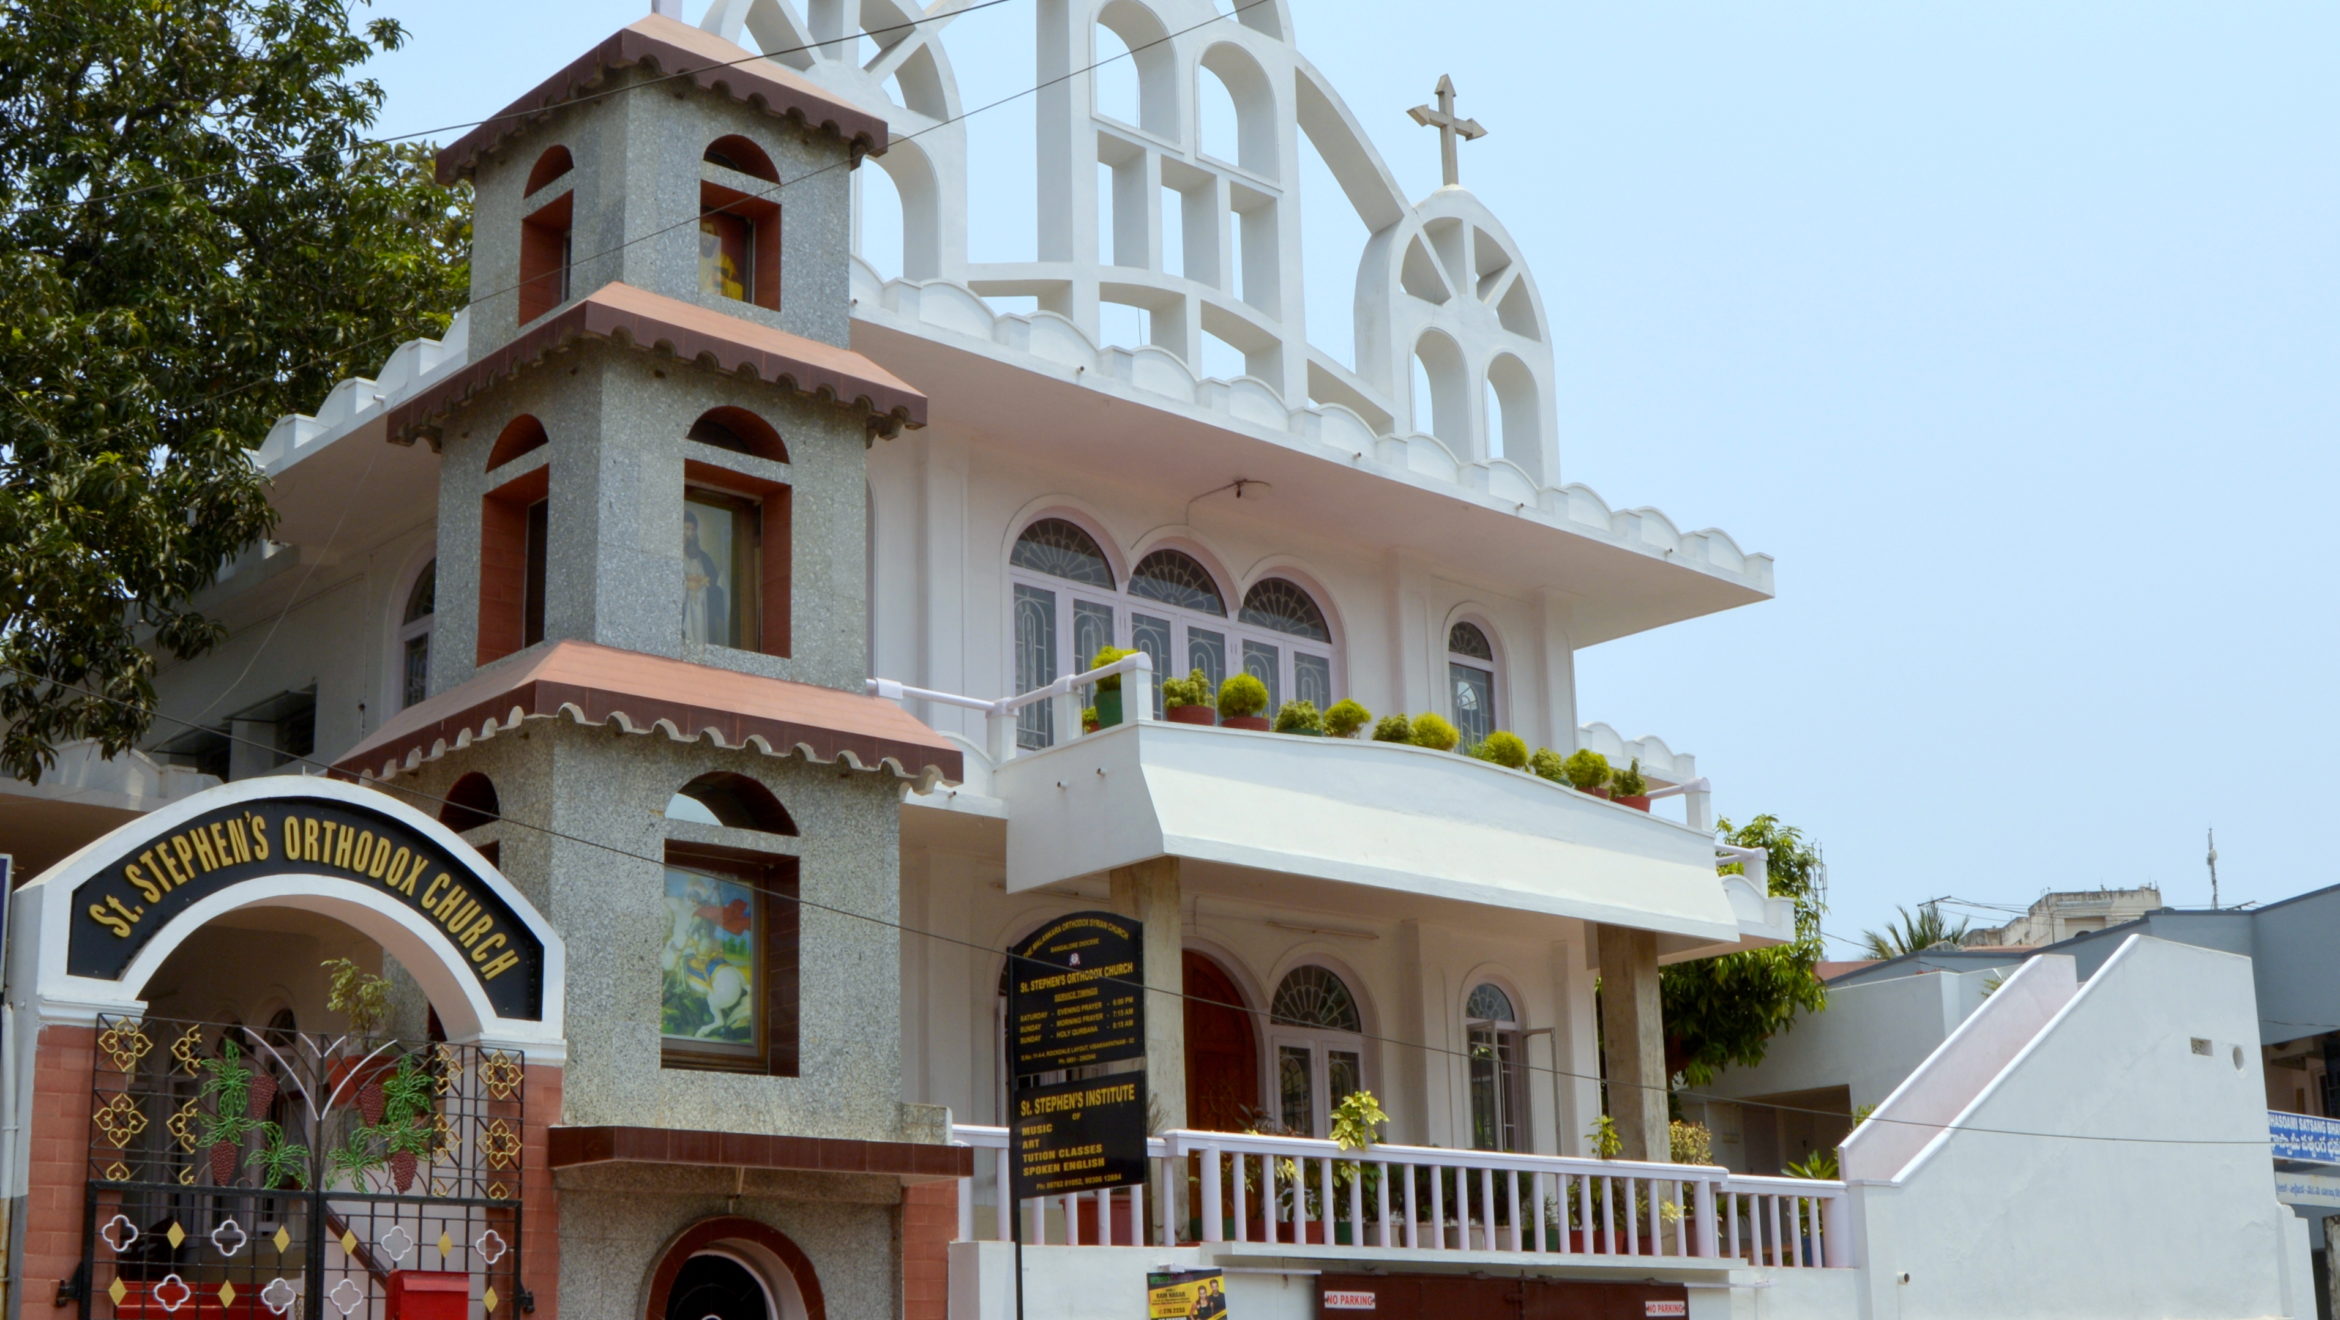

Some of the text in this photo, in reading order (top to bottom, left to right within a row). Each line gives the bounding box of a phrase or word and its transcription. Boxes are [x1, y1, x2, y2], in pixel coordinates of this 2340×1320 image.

[89, 811, 520, 981] St. STEPHEN'S ORTHODOX CHURCH
[1032, 925, 1062, 950] MALANKARA
[1062, 918, 1089, 932] ORTHODOX
[1089, 918, 1108, 930] SYRIAN
[1107, 922, 1129, 940] CHURCH
[1079, 937, 1100, 948] DIOCESE
[1020, 961, 1133, 993] St. STEPHEN'S ORTHODOX CHURCH
[1020, 1011, 1048, 1022] SATURDAY
[1057, 1005, 1080, 1017] EVENING
[1081, 1001, 1102, 1012] PRAYER
[1124, 996, 1134, 1004] PM
[1020, 1023, 1041, 1033] SUNDAY
[1056, 1017, 1081, 1028] MORNING
[1082, 1012, 1104, 1022] PRAYER
[1124, 1007, 1134, 1016] AM
[1020, 1034, 1041, 1044] SUNDAY
[1056, 1029, 1071, 1039] HOLY
[1124, 1019, 1134, 1028] AM
[1020, 1084, 1135, 1117] St. STEPHEN'S INSTITUTE
[1072, 1112, 1081, 1120] OF
[2299, 1117, 2326, 1133] SATSANG
[1022, 1123, 1053, 1136] MUSIC
[1022, 1139, 1040, 1150] ART
[1022, 1143, 1103, 1163] TUTION CLASSES
[1022, 1157, 1105, 1177] SPOKEN ENGLISH
[1327, 1295, 1373, 1305] NO PARKING
[1647, 1304, 1684, 1313] NO PARKING
